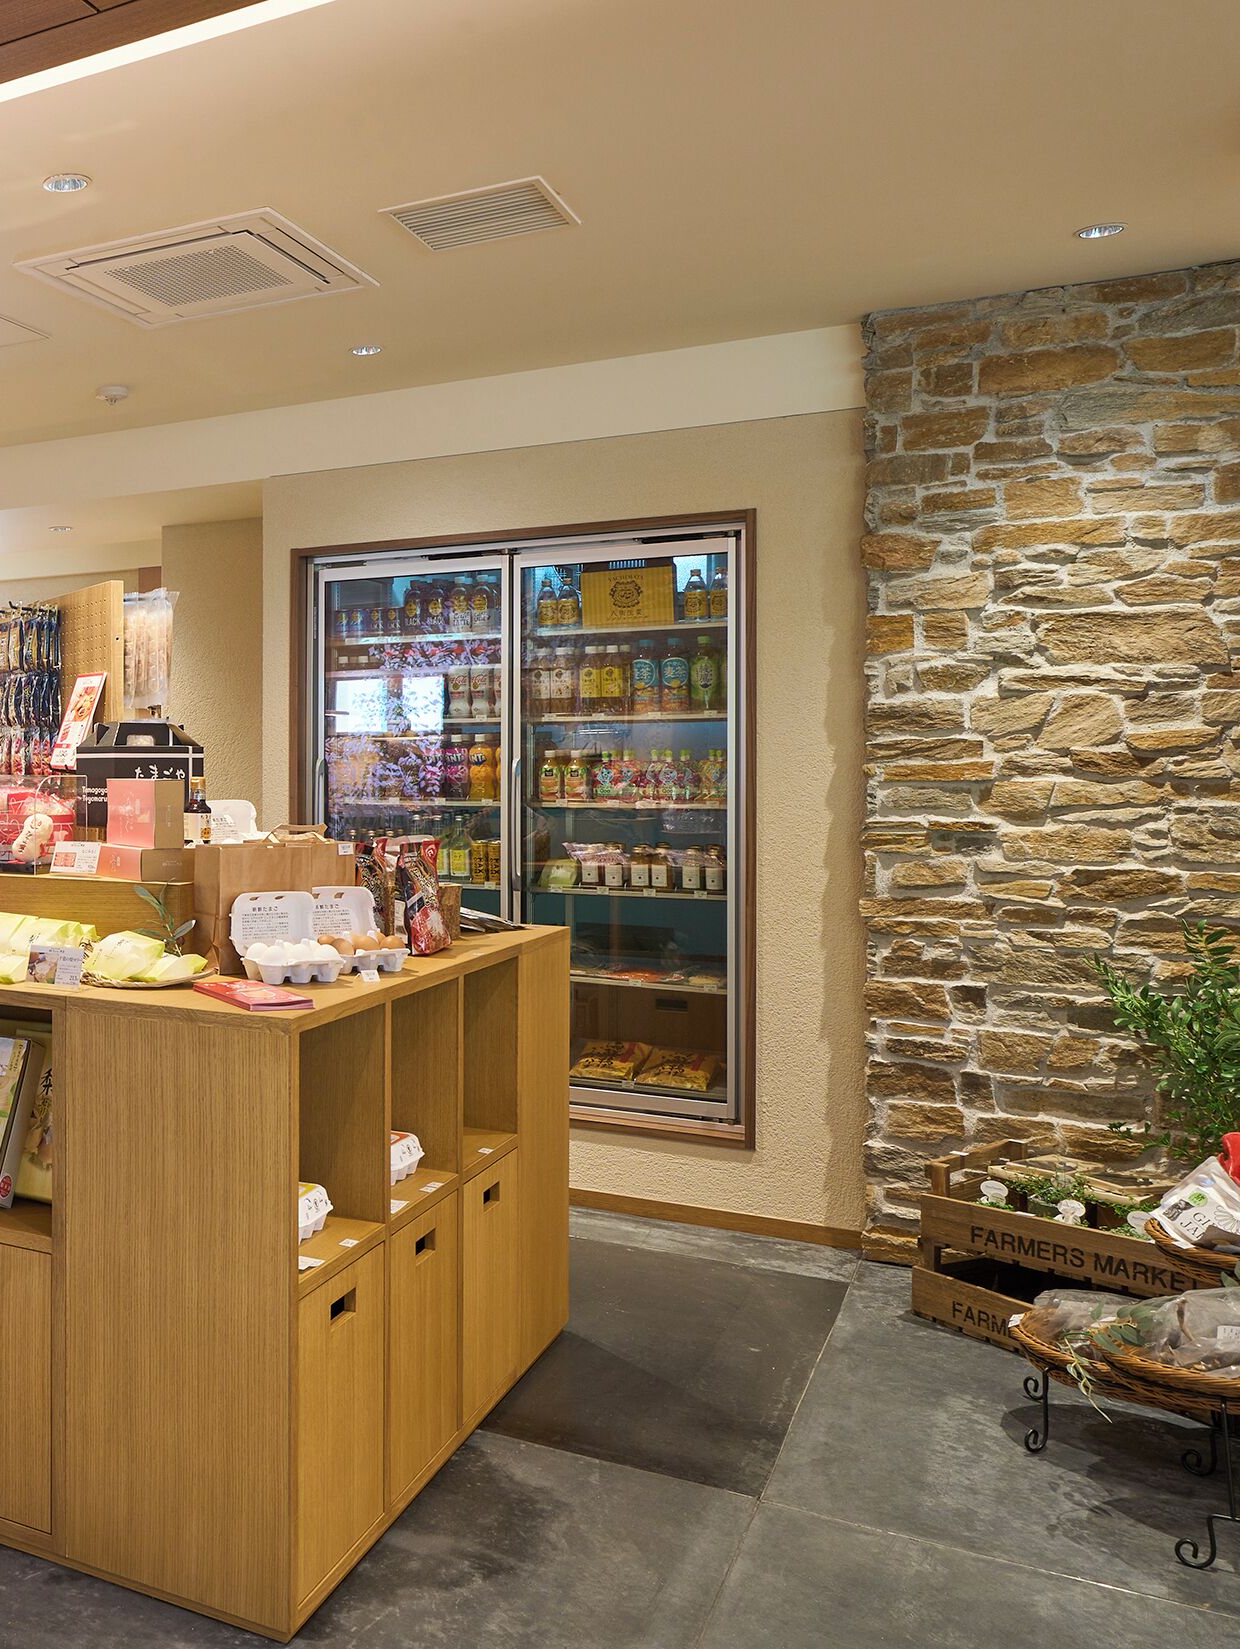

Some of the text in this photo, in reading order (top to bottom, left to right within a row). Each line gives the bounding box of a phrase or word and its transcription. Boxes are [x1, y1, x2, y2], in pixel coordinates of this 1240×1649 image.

[135, 764, 186, 780] たまごや
[970, 1225, 1085, 1269] FARMERS
[952, 1300, 1010, 1337] FARM
